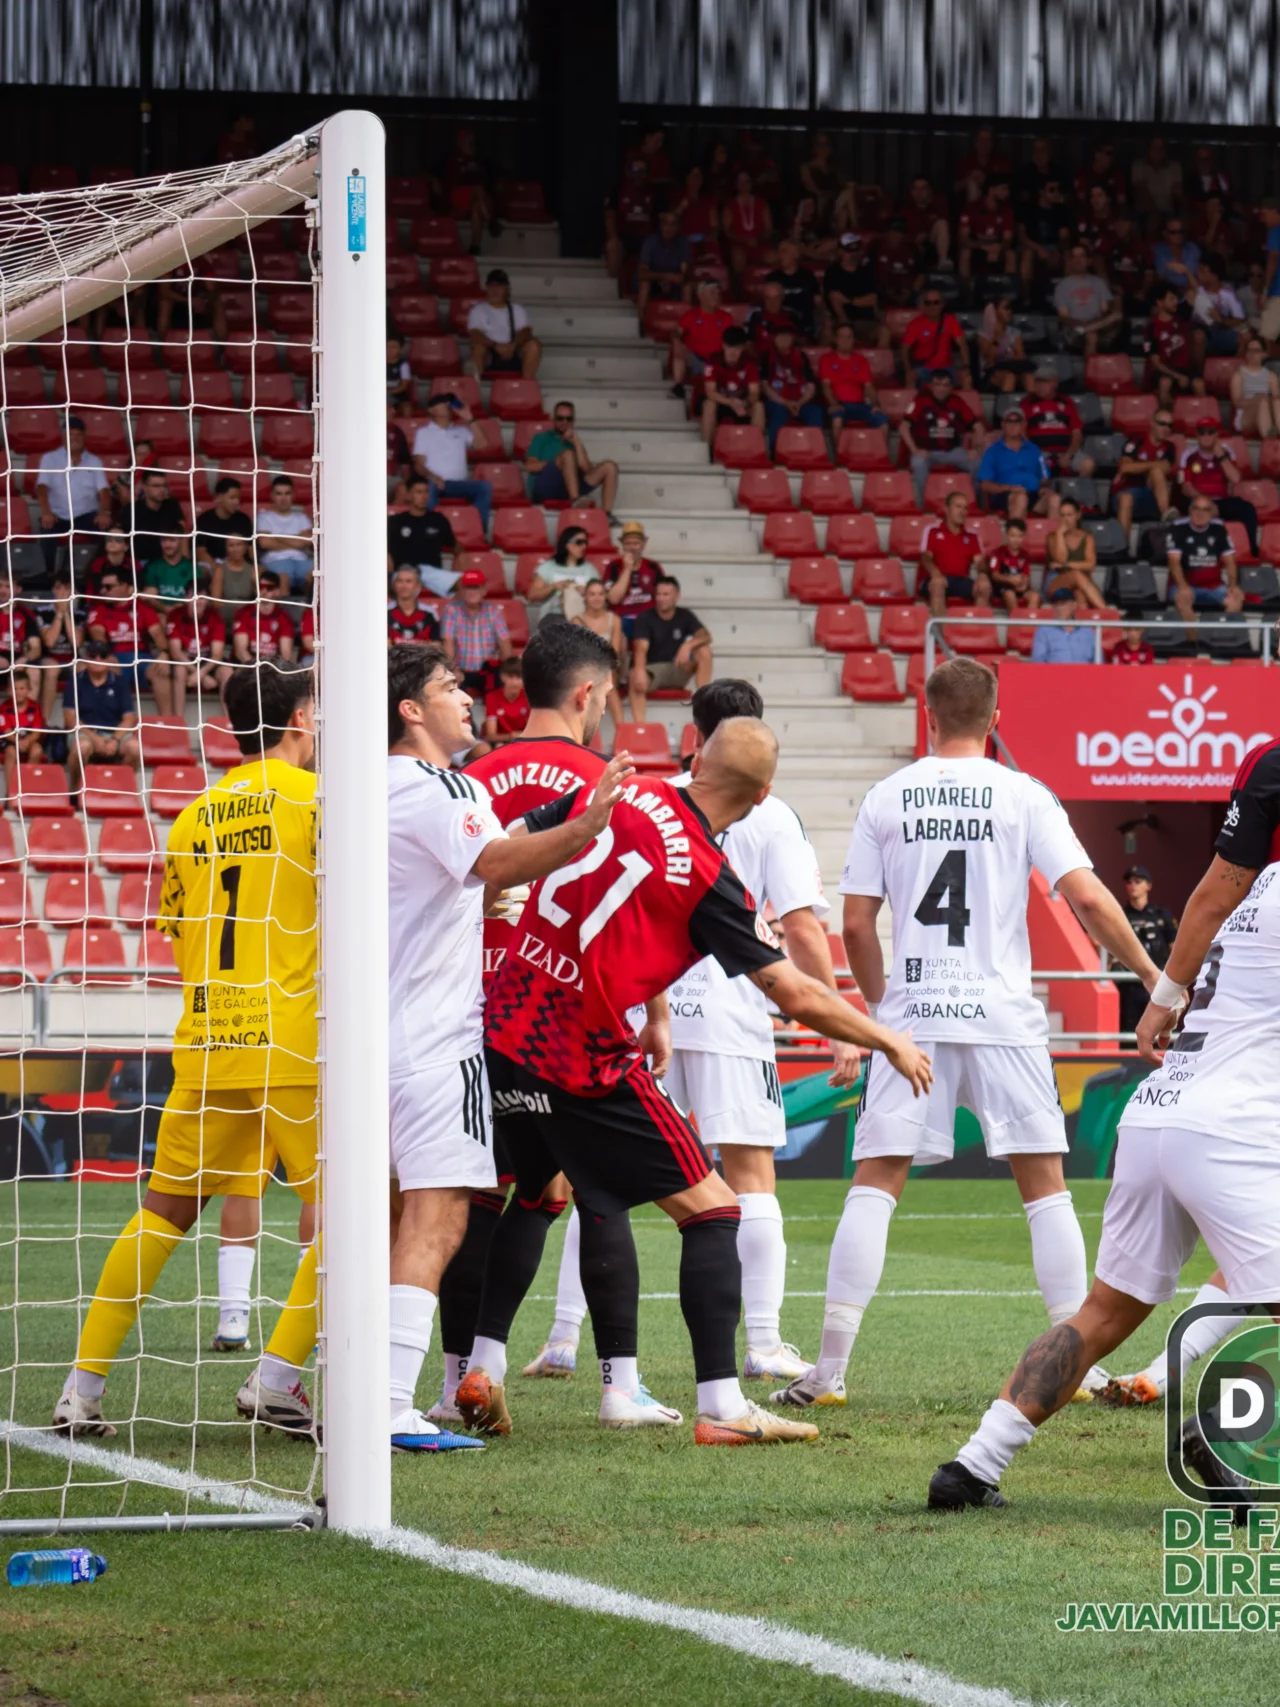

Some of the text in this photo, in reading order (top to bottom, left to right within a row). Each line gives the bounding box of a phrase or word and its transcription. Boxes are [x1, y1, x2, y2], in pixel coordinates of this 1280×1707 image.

[902, 786, 993, 813] POVARELO
[198, 788, 277, 828] POVARELO
[902, 818, 994, 844] LABRADA
[537, 825, 654, 955] 21
[913, 849, 971, 948] 4
[220, 865, 242, 971] 1
[924, 958, 962, 969] XUNTA
[924, 969, 985, 982] DE GALICIA
[686, 987, 707, 997] 2027
[905, 985, 985, 997] Xacobeo 2027
[223, 997, 269, 1010] GALICIA
[246, 1013, 269, 1024] 2027
[1169, 1071, 1194, 1082] 2027
[1128, 1087, 1181, 1107] ANCA
